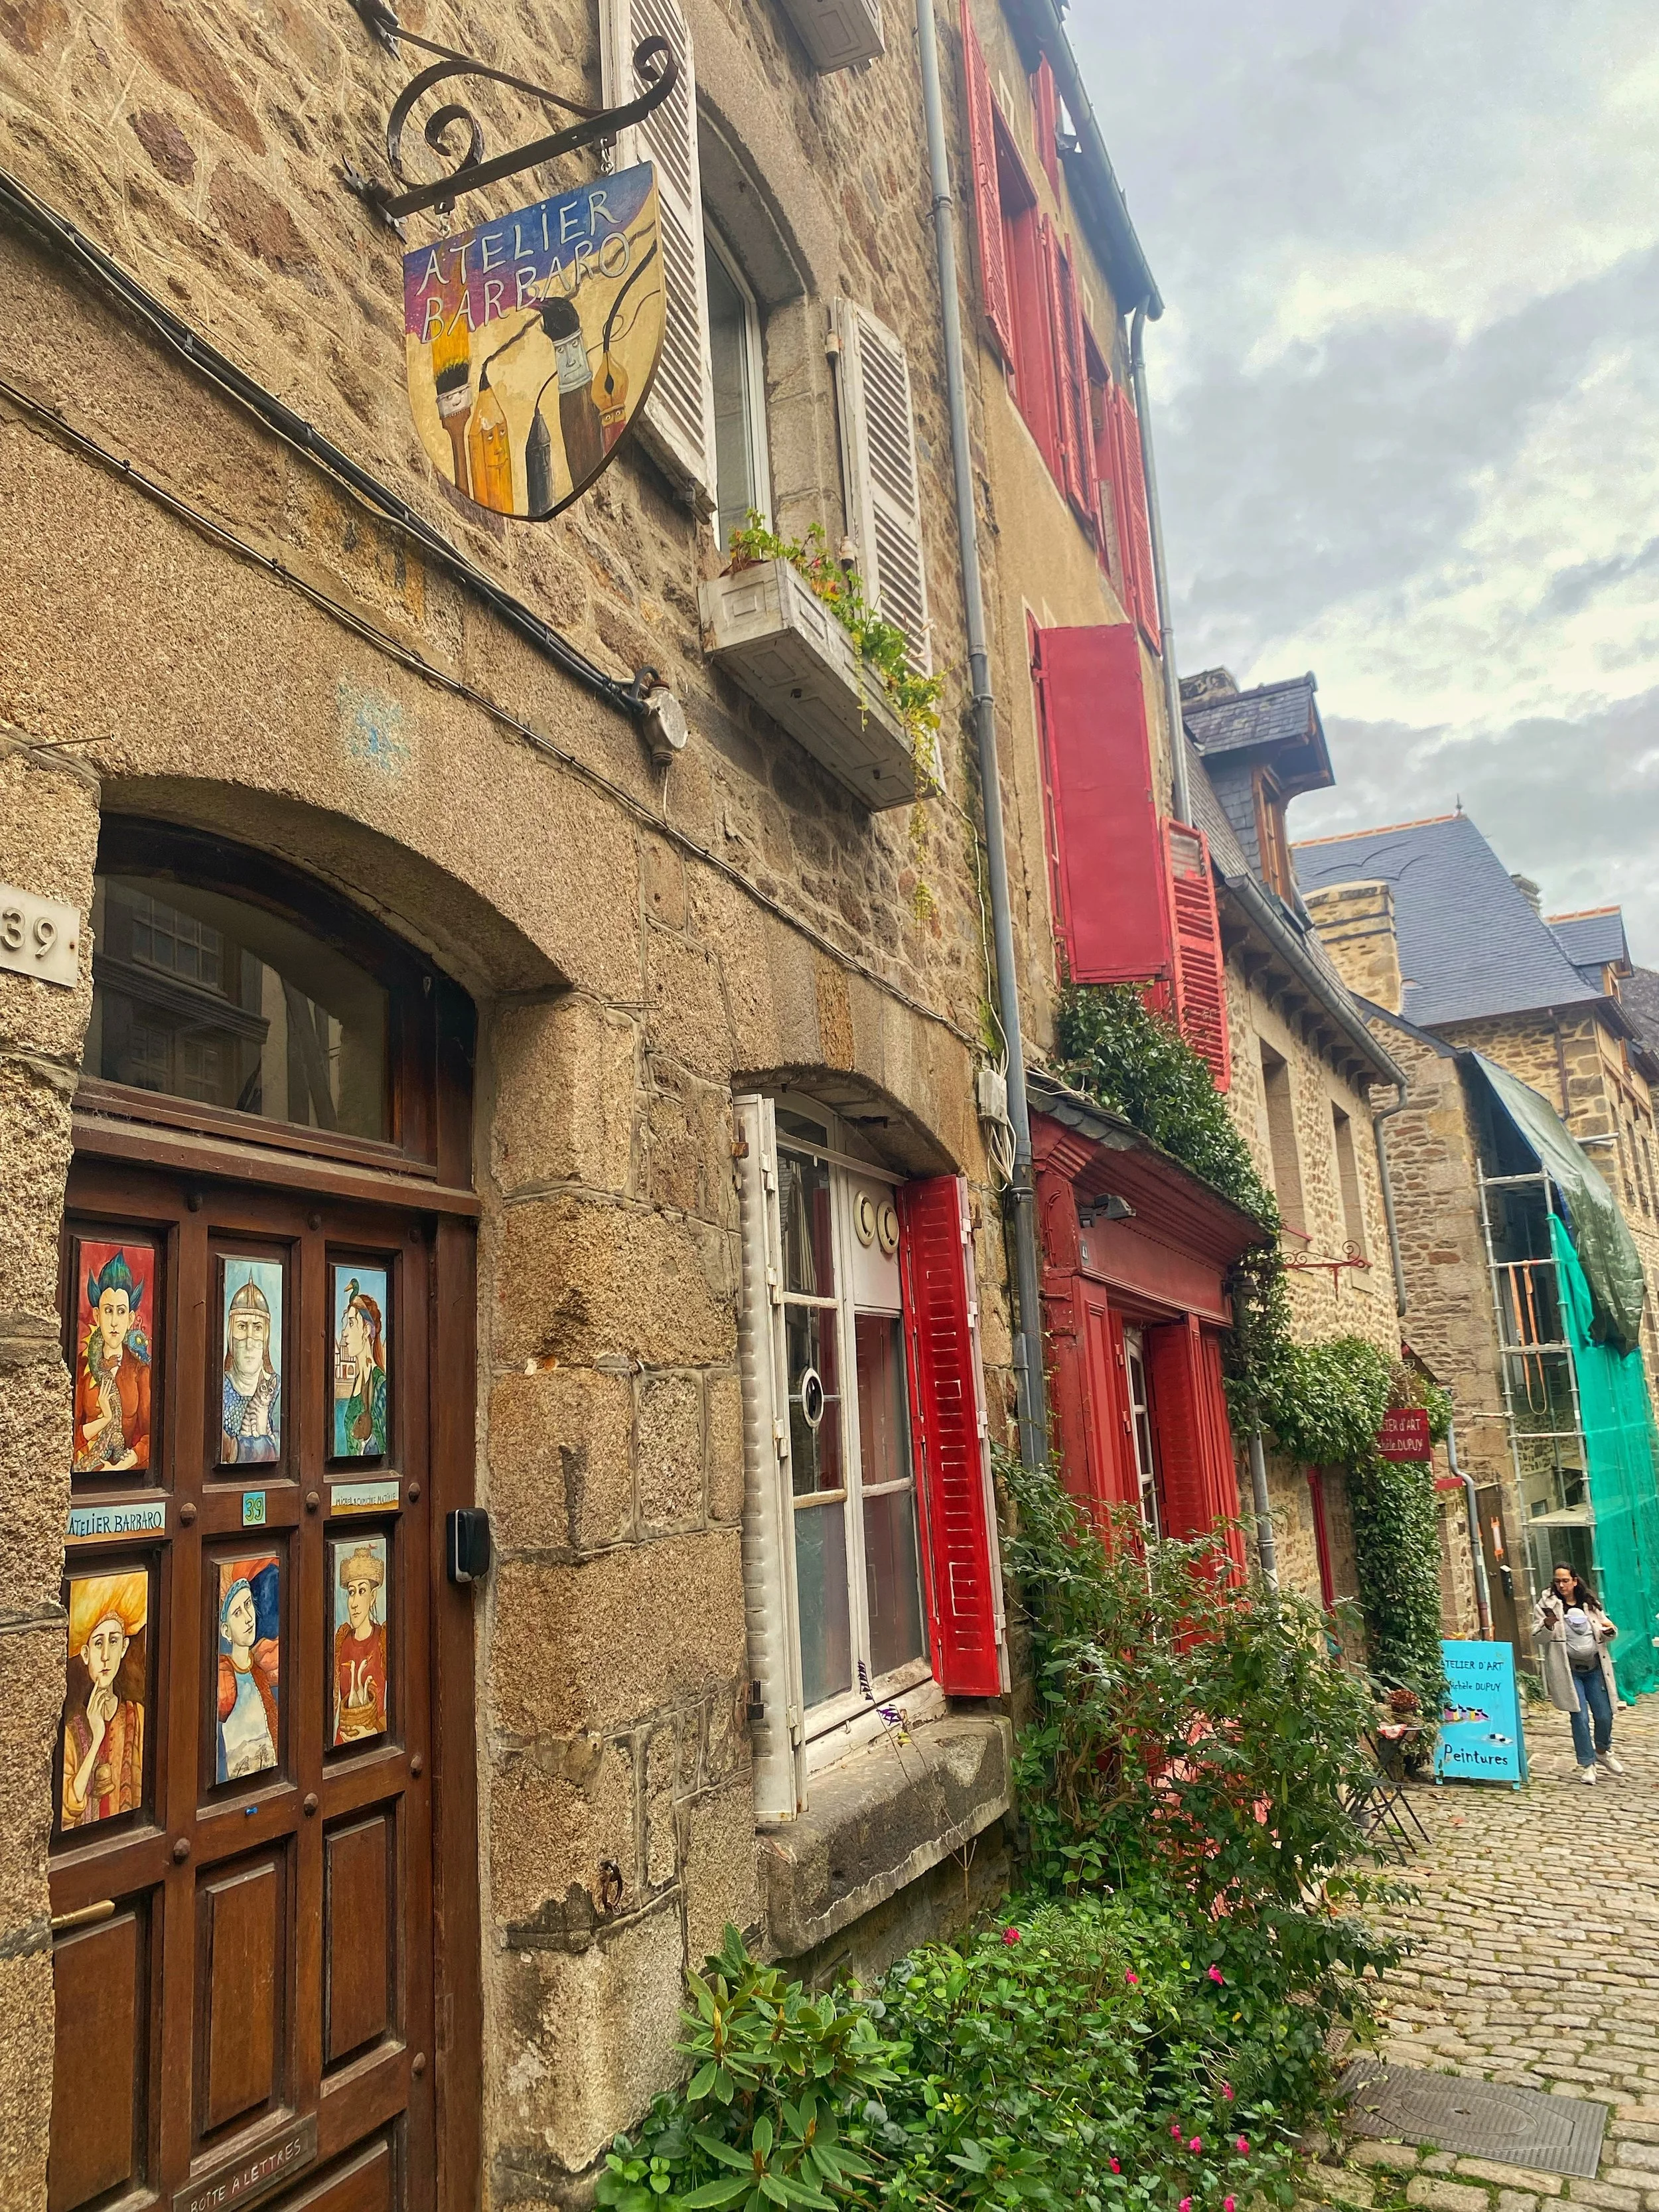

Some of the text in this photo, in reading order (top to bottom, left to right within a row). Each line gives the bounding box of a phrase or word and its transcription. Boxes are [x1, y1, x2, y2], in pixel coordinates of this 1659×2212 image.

[421, 232, 629, 344] BARBARO
[1, 907, 58, 958] 39
[1398, 1438, 1423, 1451] DUPUY
[246, 1497, 263, 1521] 39
[114, 1511, 162, 1533] BARBARO
[1479, 1662, 1504, 1670] D'ART
[1476, 1682, 1501, 1692] DUPUY
[1445, 1744, 1508, 1765] Peintures
[191, 2185, 226, 2212] BOÎTE
[244, 2138, 301, 2185] LETTRES
